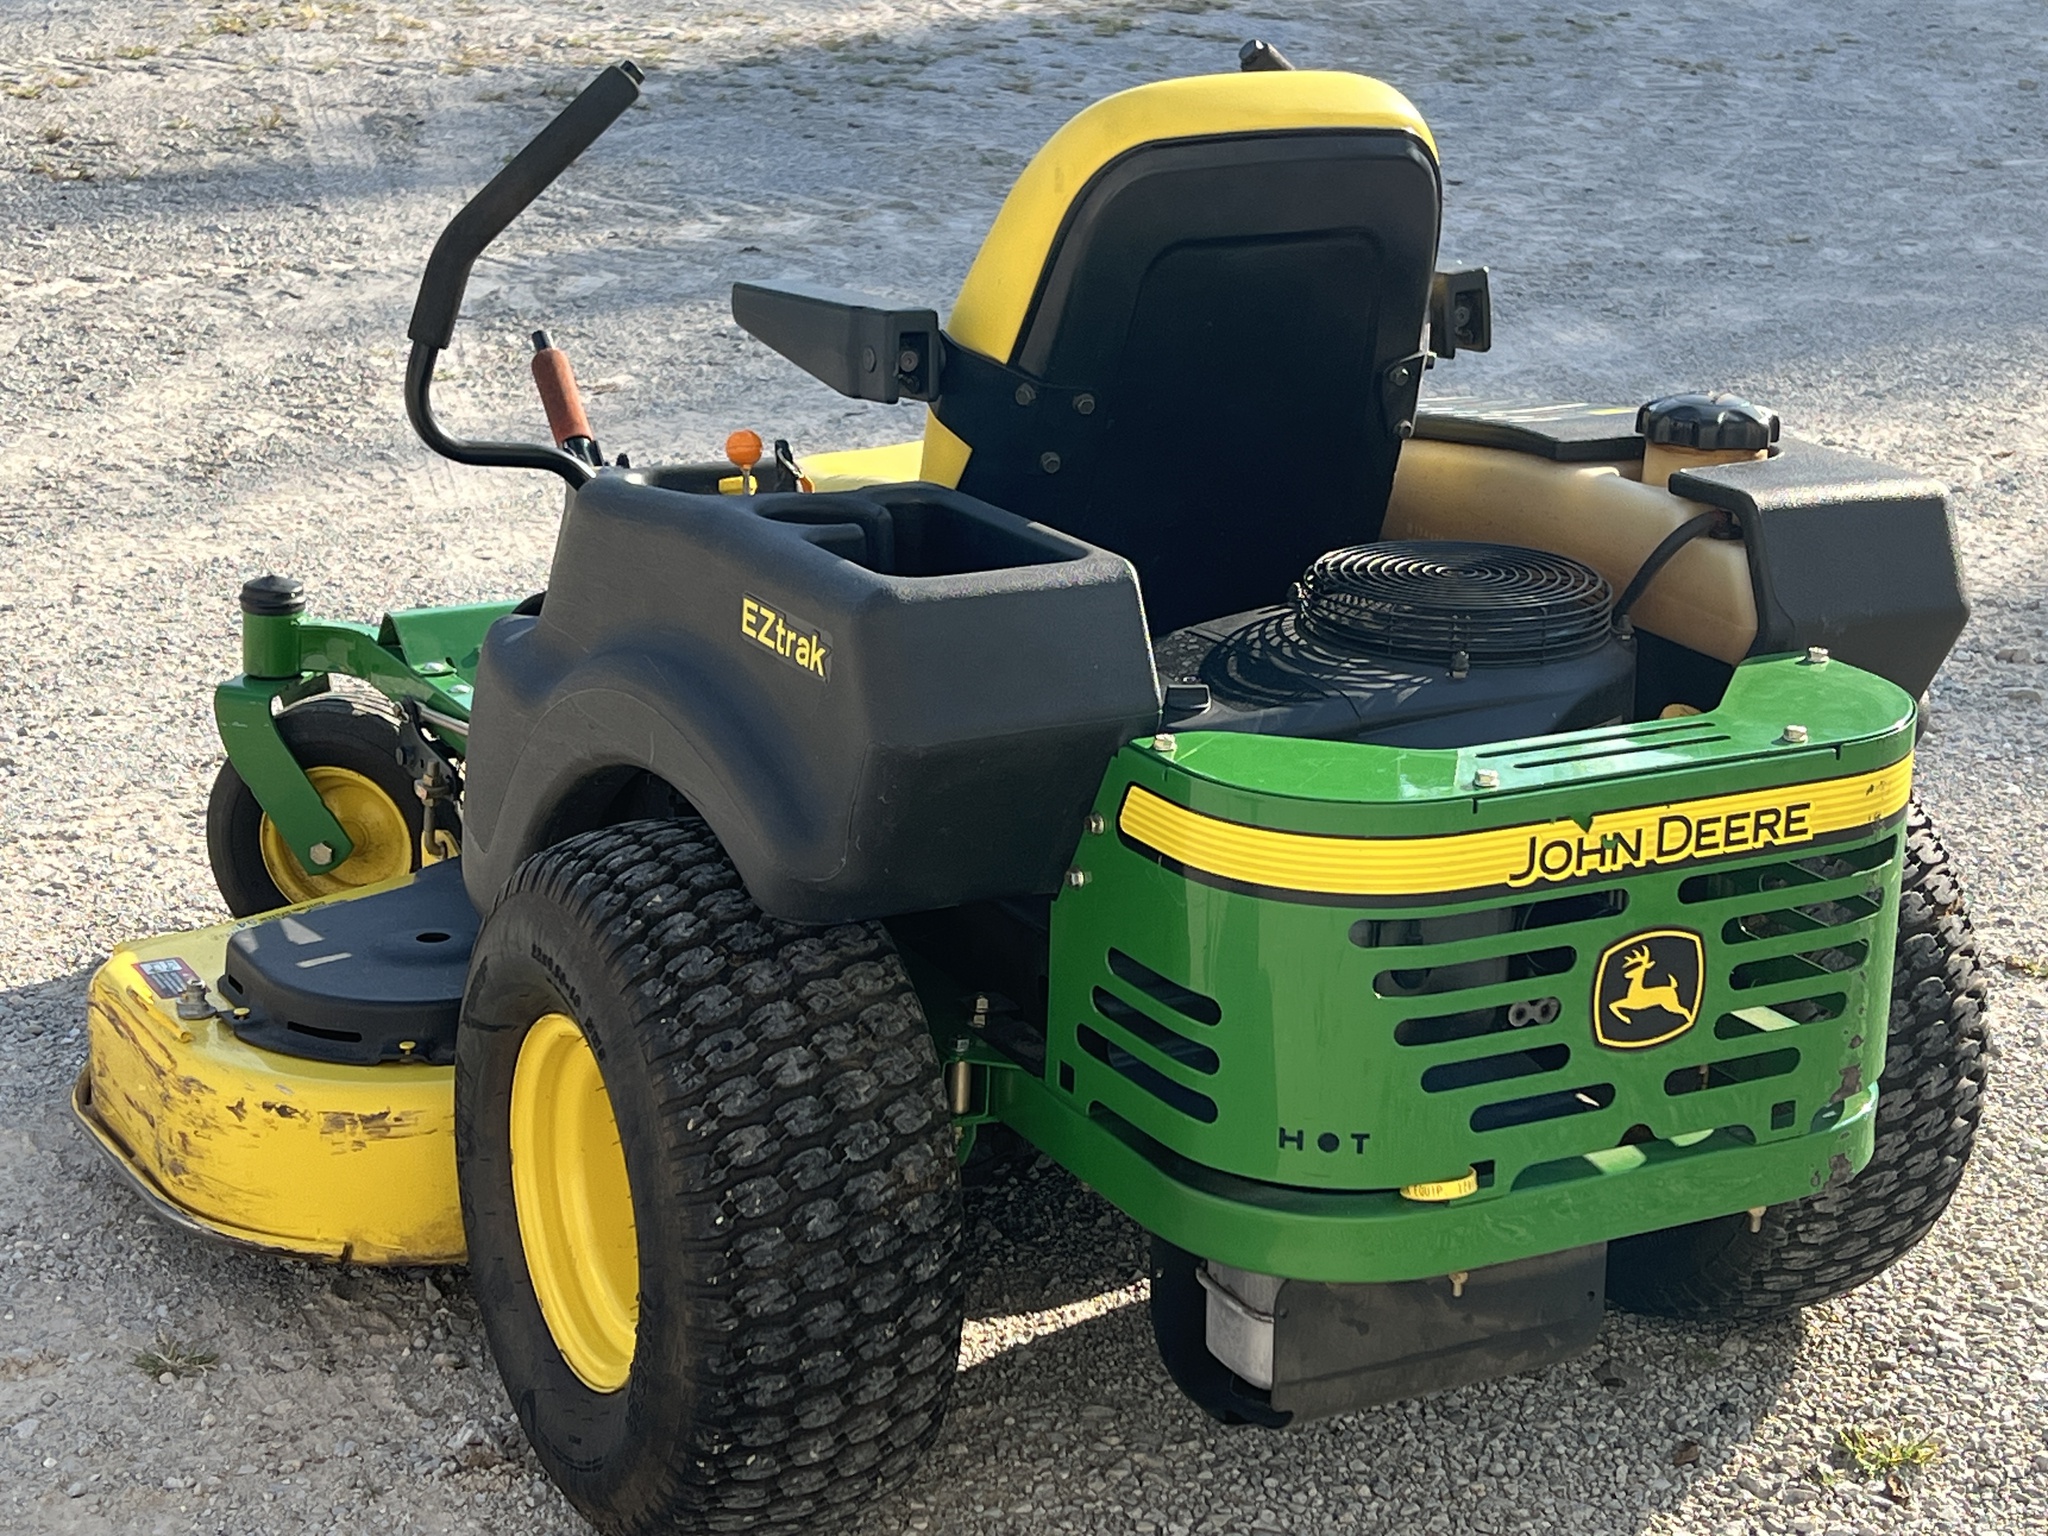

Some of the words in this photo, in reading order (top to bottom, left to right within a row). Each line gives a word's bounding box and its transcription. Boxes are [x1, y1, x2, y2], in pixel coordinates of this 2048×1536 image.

[742, 598, 826, 677] EZtrak
[1508, 828, 1643, 882] JOHN
[1658, 802, 1811, 854] DEERE
[1278, 1126, 1371, 1155] HOT
